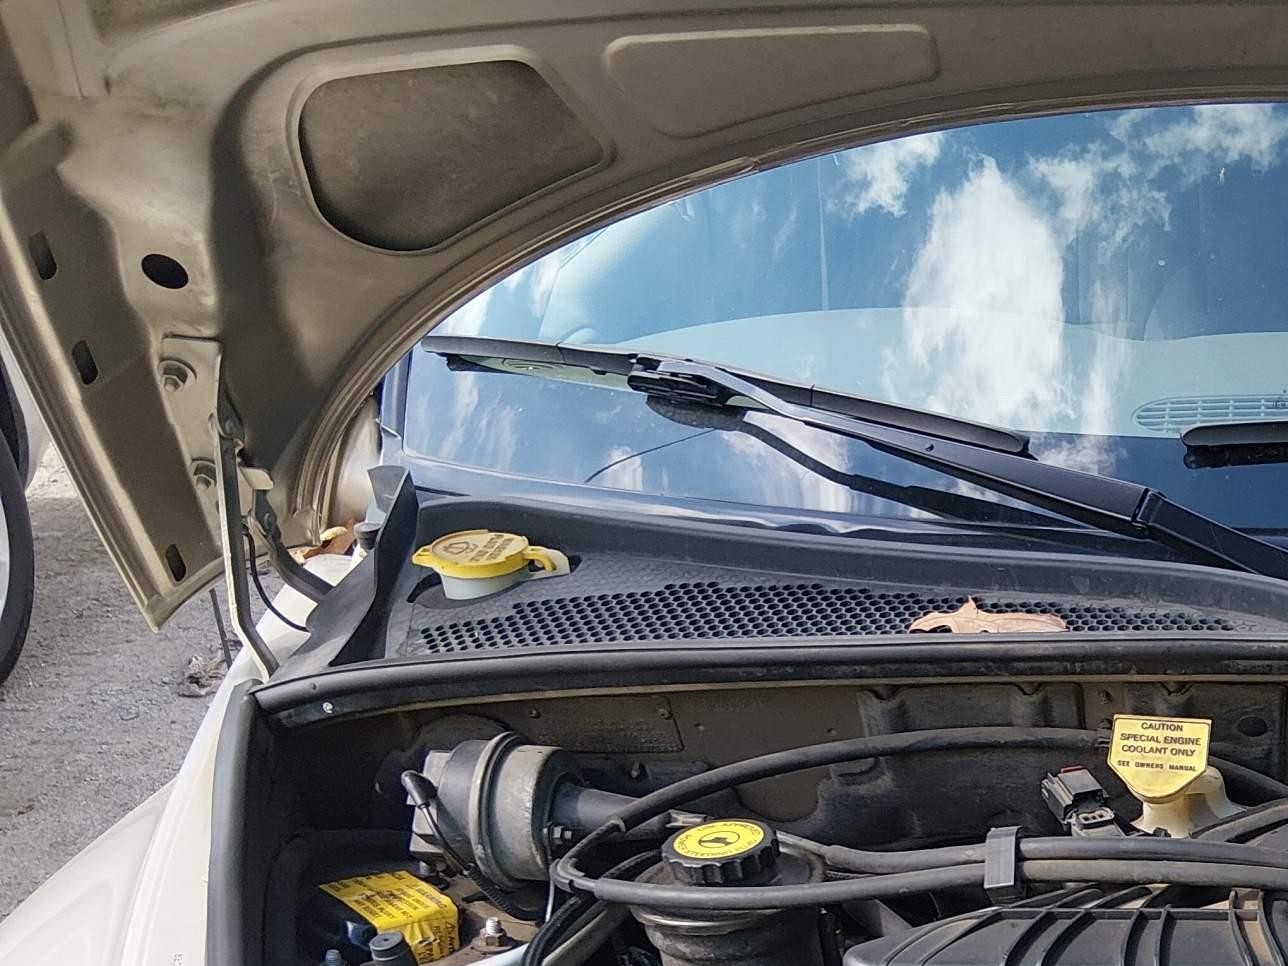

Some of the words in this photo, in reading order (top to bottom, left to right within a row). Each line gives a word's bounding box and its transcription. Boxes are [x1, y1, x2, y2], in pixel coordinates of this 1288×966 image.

[1141, 722, 1183, 732] CAUTION
[1120, 733, 1160, 743] SPECIAL
[1164, 735, 1201, 746] ENGINE
[1122, 744, 1167, 754] COOLANT
[1170, 748, 1196, 756] ONLY
[1135, 761, 1164, 769] OWNERS
[1169, 764, 1196, 772] MANUAL
